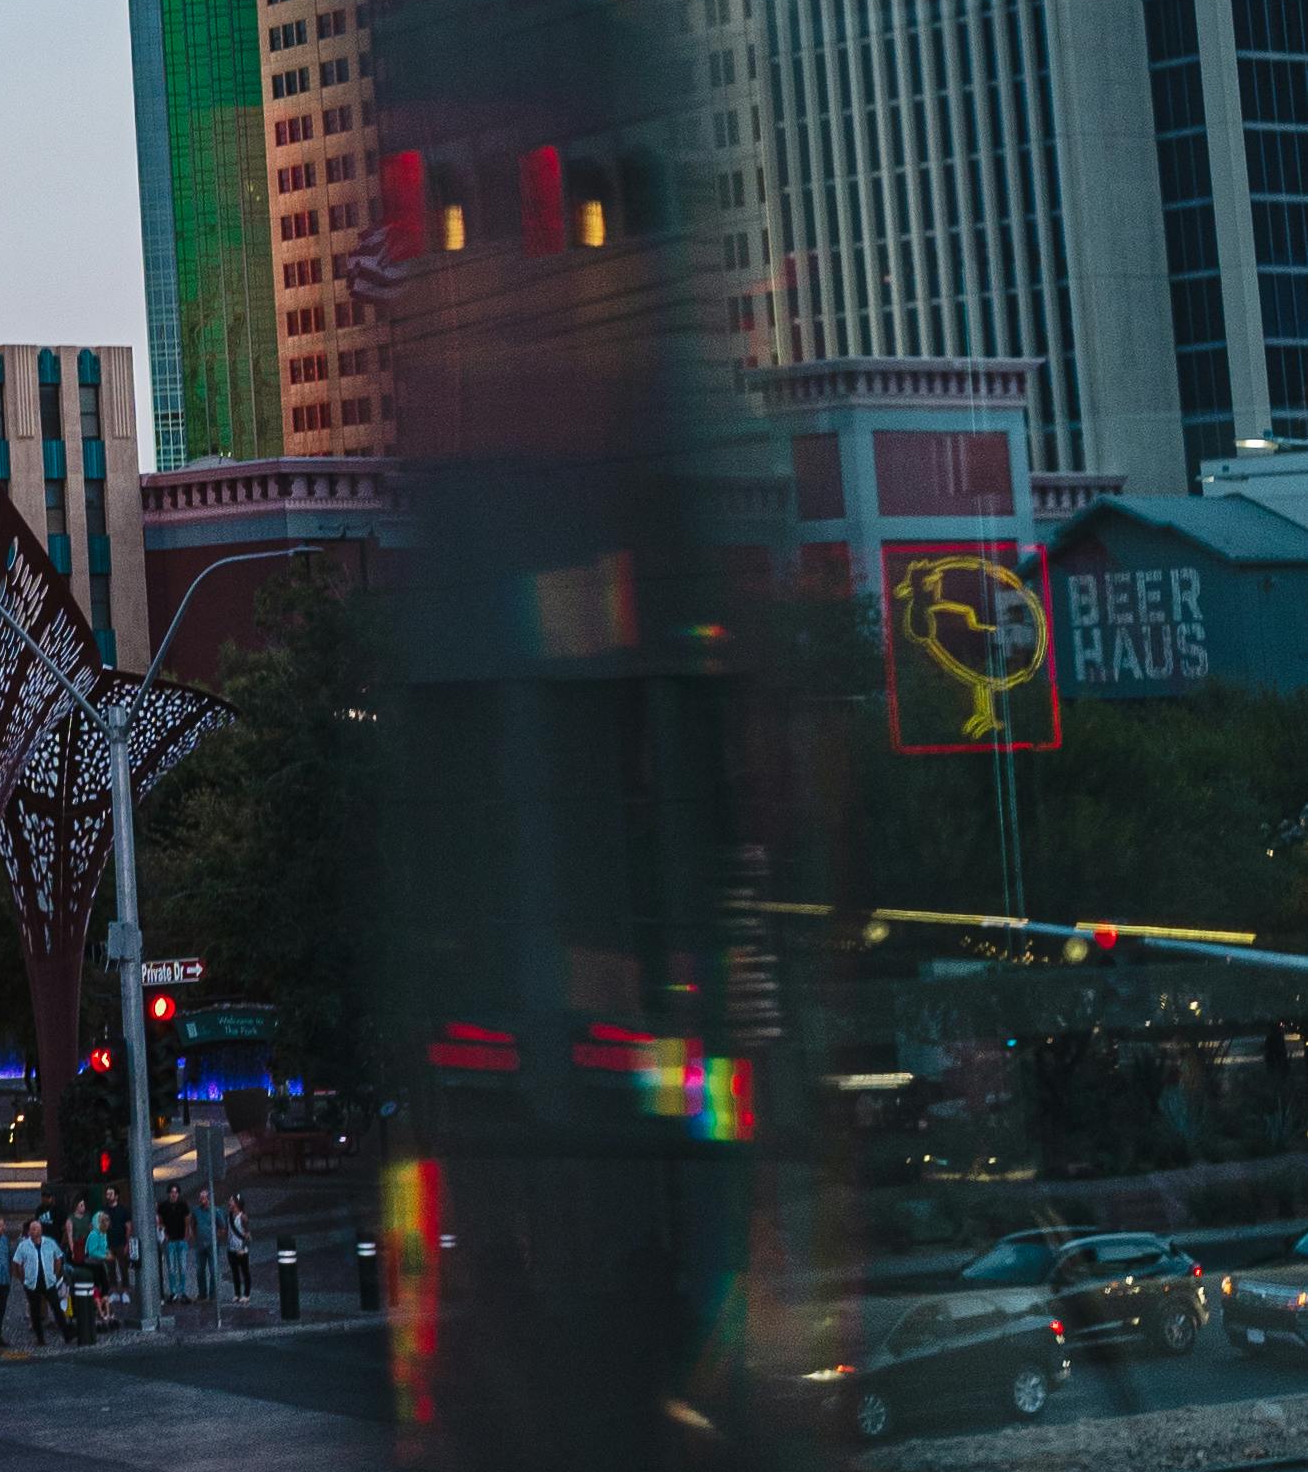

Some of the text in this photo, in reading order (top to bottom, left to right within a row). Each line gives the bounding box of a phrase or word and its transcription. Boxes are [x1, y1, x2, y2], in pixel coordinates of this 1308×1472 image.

[1068, 568, 1203, 626] BEER
[1073, 622, 1209, 682] HAUS
[142, 961, 185, 983] Private Dr
